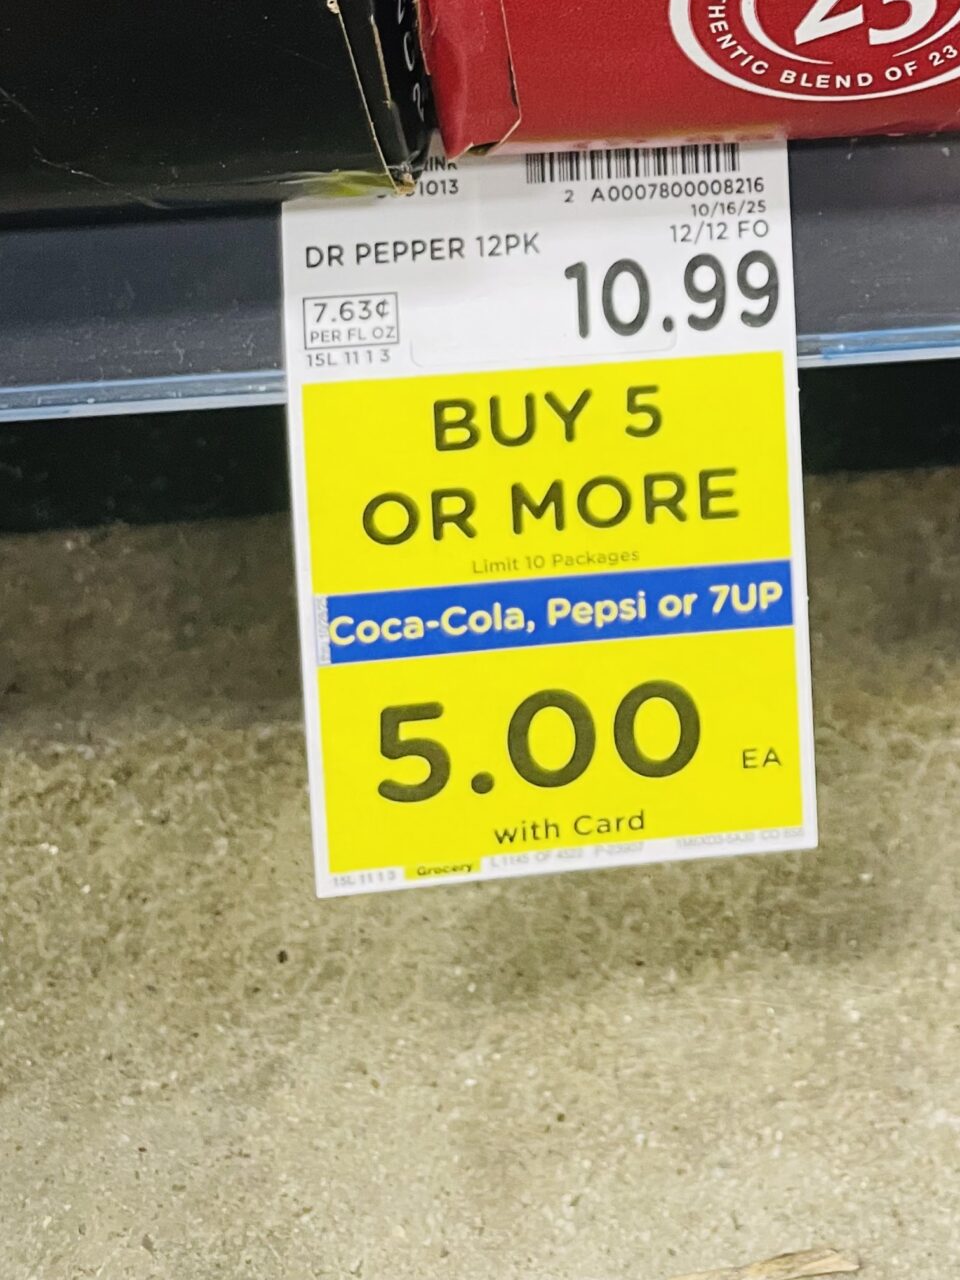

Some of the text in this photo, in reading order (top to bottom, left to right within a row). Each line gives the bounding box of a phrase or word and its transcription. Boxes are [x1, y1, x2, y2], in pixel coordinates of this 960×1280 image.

[779, 69, 874, 89] BLEND
[884, 60, 918, 81] OF
[928, 44, 958, 67] 23
[564, 177, 765, 203] 2 A0007800008216
[691, 200, 767, 218] 10/16/25
[670, 219, 770, 245] 12/12 FO
[305, 231, 540, 269] DR PEPPER 12PK
[564, 249, 780, 340] 10.99
[313, 298, 390, 324] 7.63¢
[310, 326, 396, 344] PER FL OZ
[306, 348, 391, 368] 15L 11 1 3
[433, 384, 663, 452] BUY 5
[362, 467, 740, 547] OR MORE
[471, 549, 640, 575] Limit 10 Packages
[328, 601, 537, 648] Coca-Cola,
[547, 591, 647, 633] Pepsi
[659, 589, 699, 619] or
[708, 579, 785, 616] 7UP
[377, 679, 783, 803] 5.00 EA
[493, 809, 646, 845] with Card
[416, 862, 473, 878] Grocery
